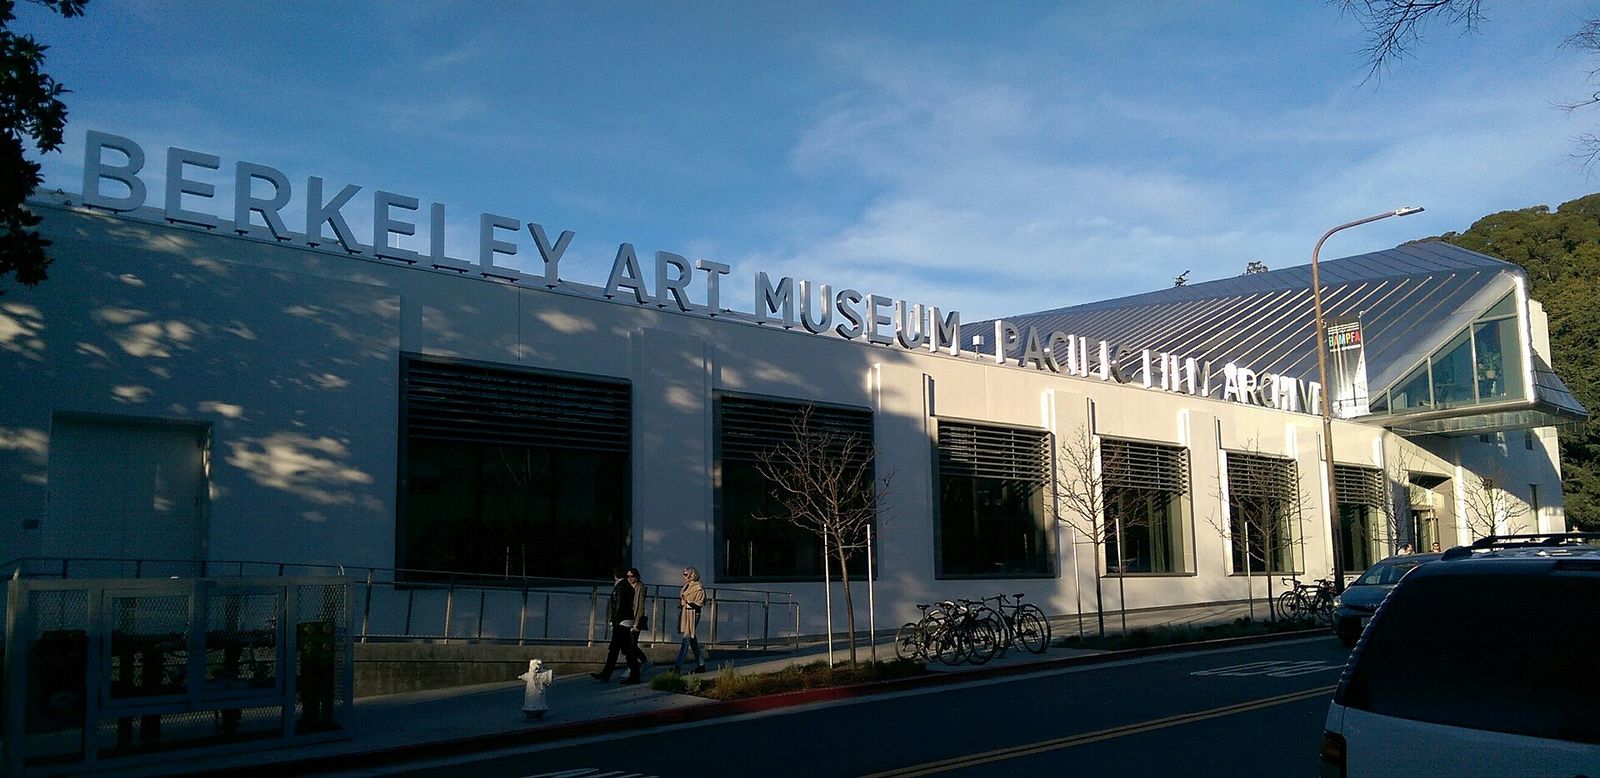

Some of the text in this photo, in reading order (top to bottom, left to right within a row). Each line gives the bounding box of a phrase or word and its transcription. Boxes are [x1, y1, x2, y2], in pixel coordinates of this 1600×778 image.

[82, 129, 576, 289] BERKELEY
[604, 242, 731, 317] ART
[754, 271, 961, 357] MUSEUM
[994, 319, 1134, 384] PACIFIC
[1142, 349, 1210, 397] FILM
[1328, 331, 1361, 347] BAMPFA
